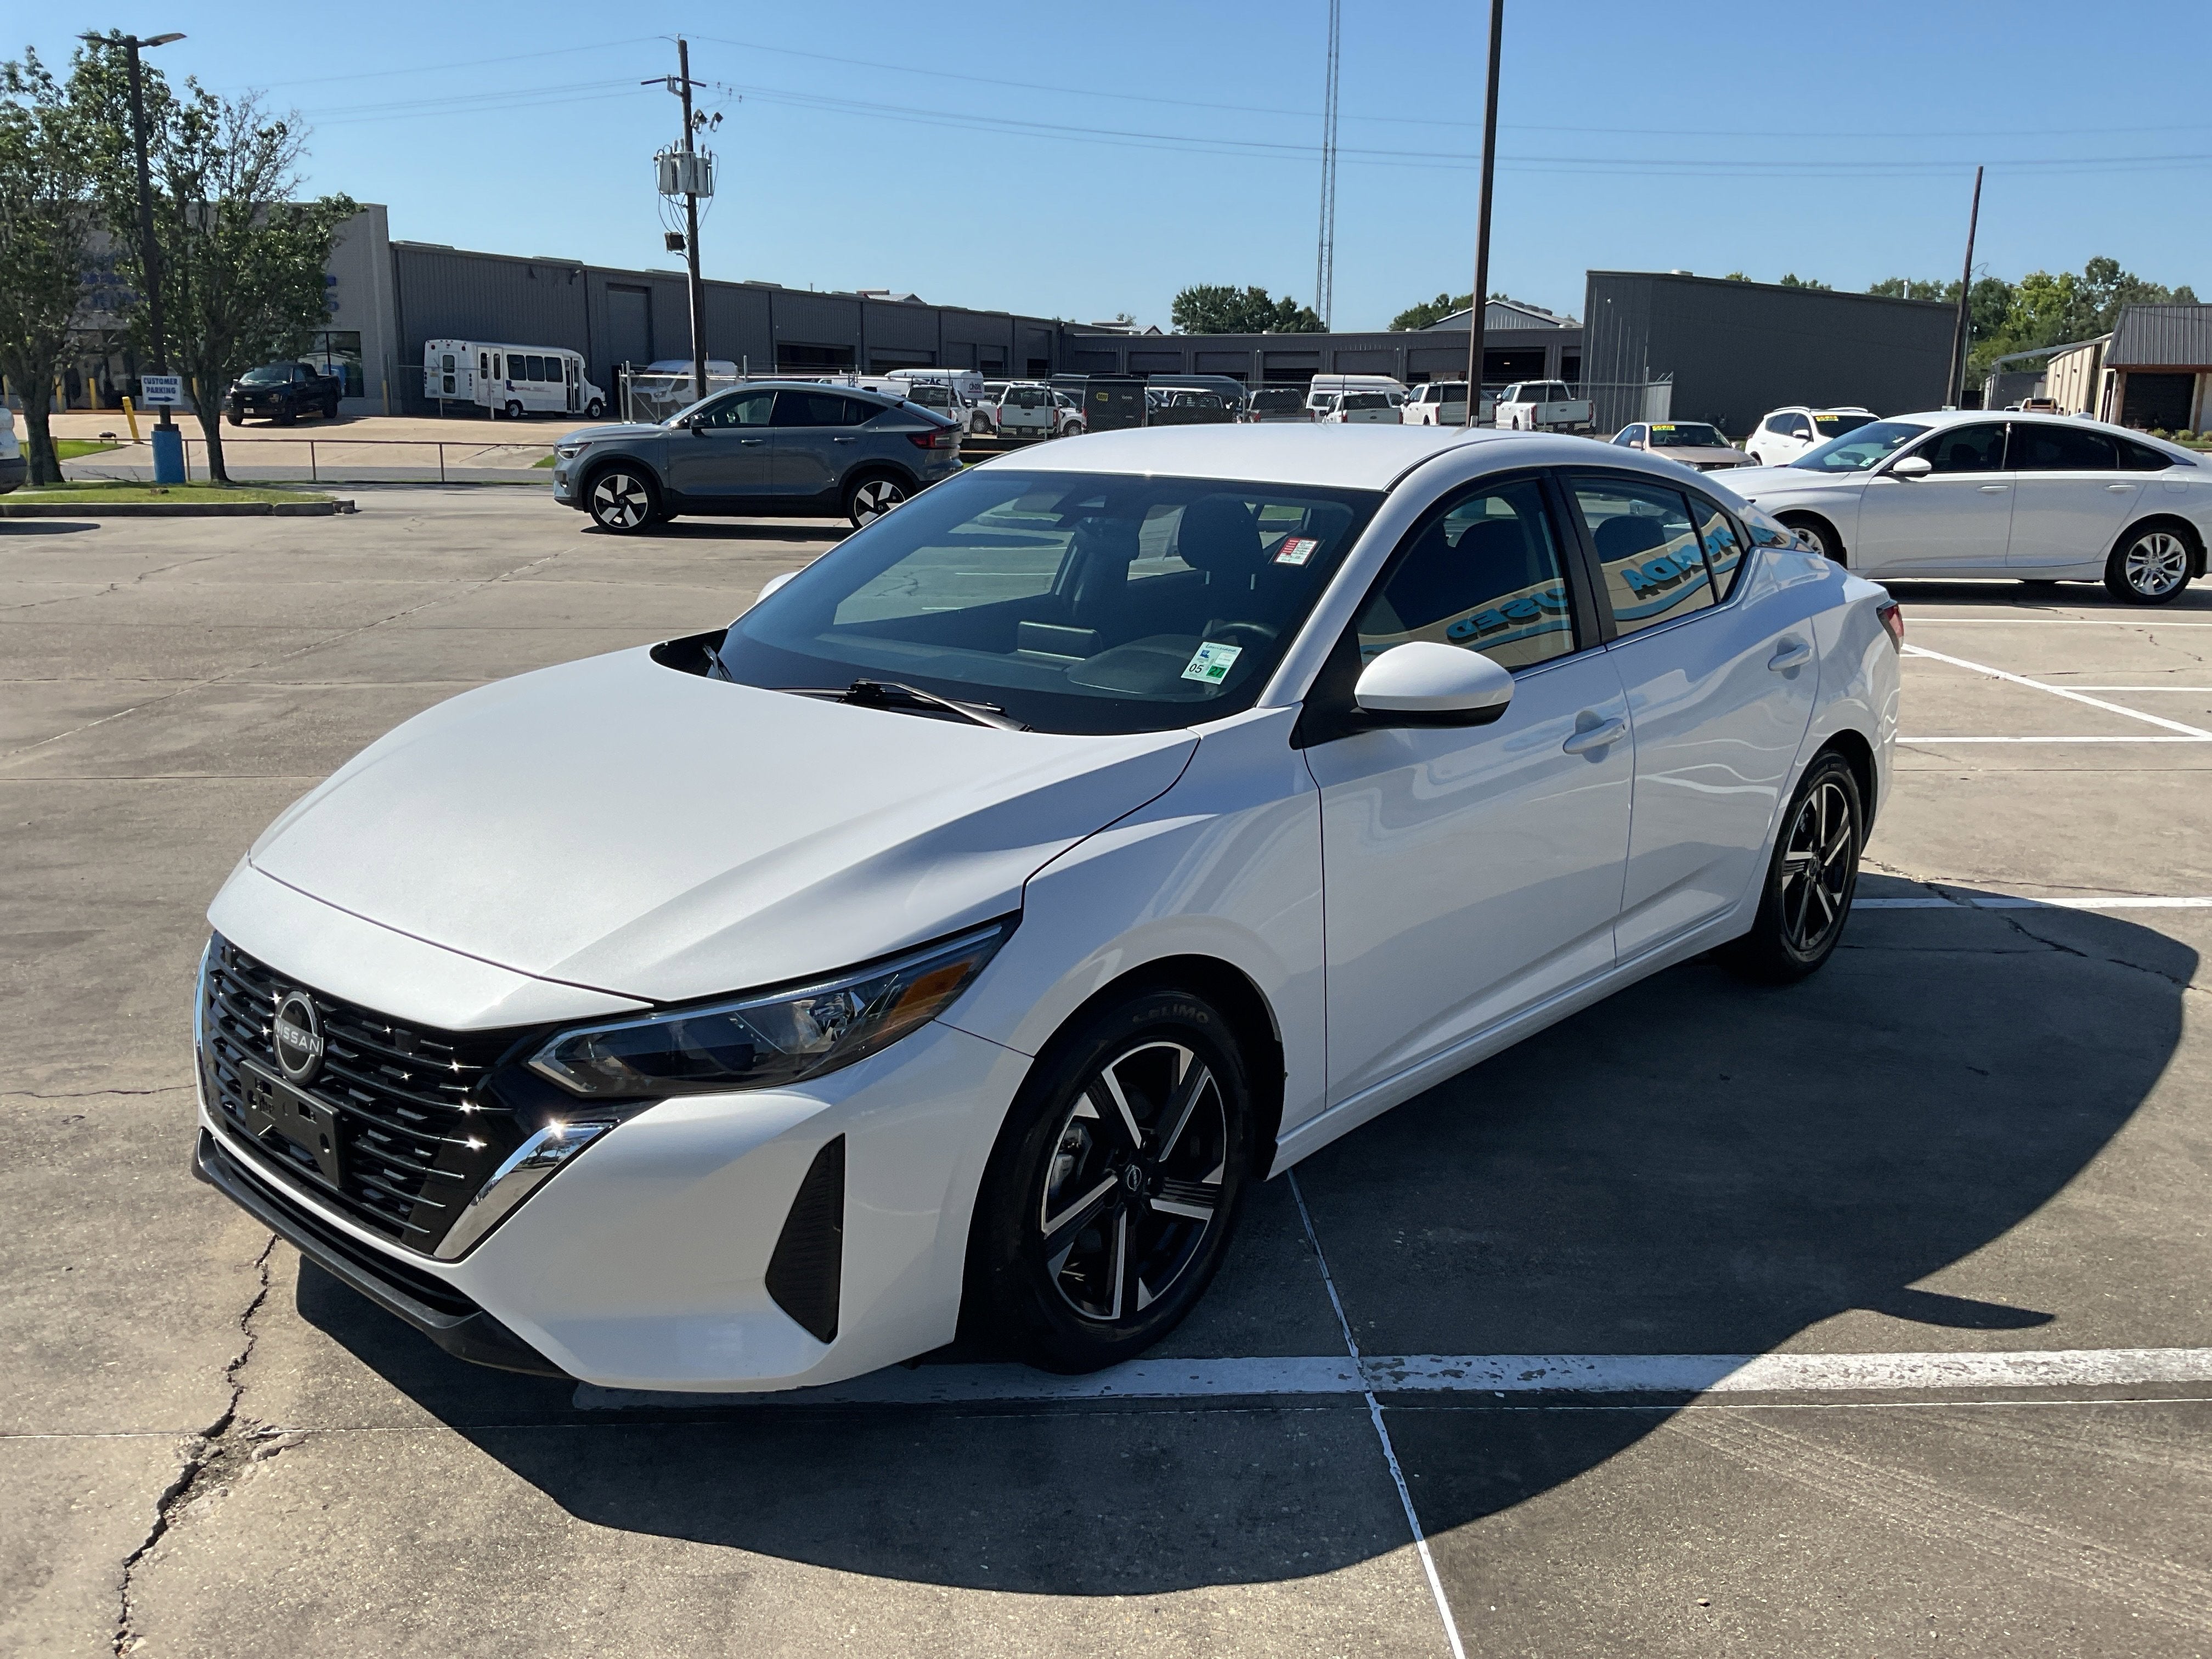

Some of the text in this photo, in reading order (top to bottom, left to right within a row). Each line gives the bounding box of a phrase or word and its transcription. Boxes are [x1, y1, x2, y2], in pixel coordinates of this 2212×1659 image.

[143, 377, 178, 385] CUSTOMER
[1189, 663, 1223, 676] 05 27
[274, 1018, 320, 1053] NISSAN
